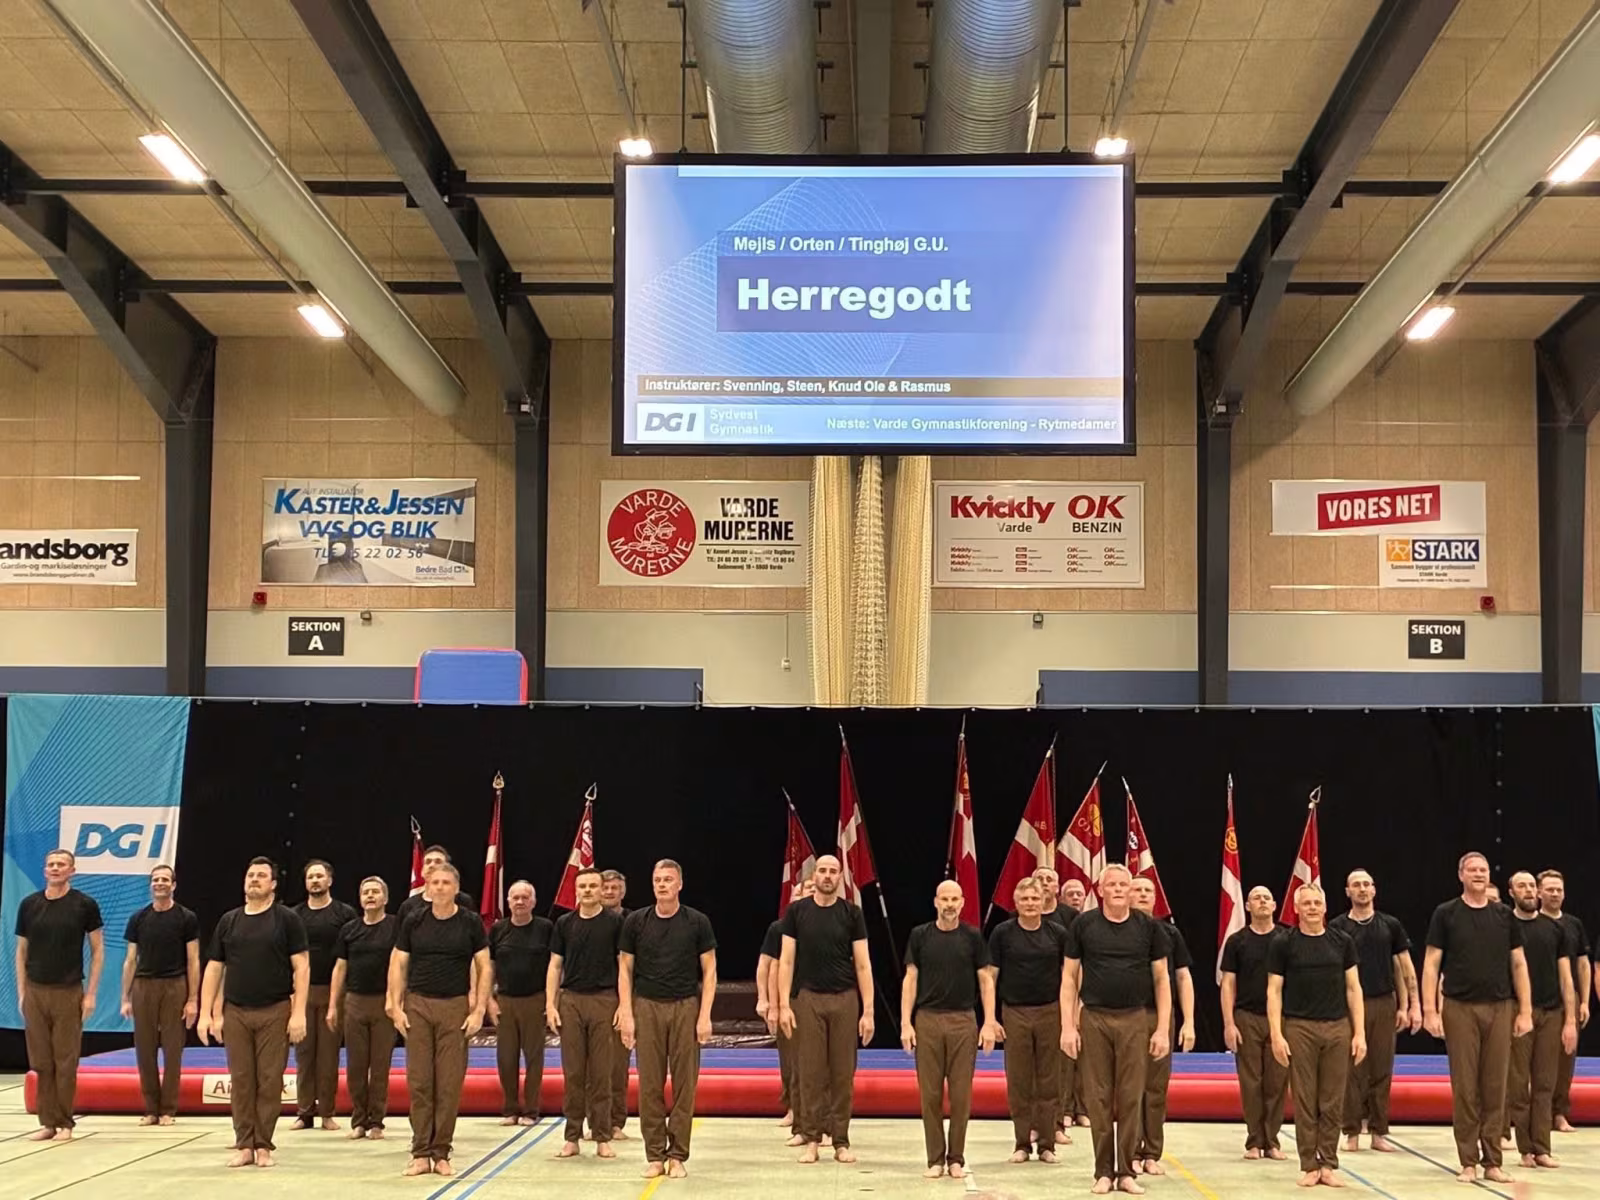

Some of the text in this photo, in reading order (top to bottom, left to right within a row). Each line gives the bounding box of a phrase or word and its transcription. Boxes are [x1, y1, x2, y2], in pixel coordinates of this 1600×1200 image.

[734, 237, 776, 254] Mejls
[790, 237, 834, 251] Orten
[848, 237, 909, 255] Tinghøj
[914, 237, 948, 251] G.U.
[738, 278, 971, 319] Herregodt
[645, 379, 951, 393] Instruktører: Svenning, Steen, Knud Ole & Rasmus
[644, 412, 697, 432] DGI
[710, 409, 758, 422] Sydvest
[710, 424, 774, 436] Gymnastik
[827, 418, 870, 430] Næste:
[873, 418, 908, 430] Varde
[911, 418, 1028, 432] Gymnastikforening
[1039, 418, 1117, 432] Rytmedamer
[274, 488, 465, 515] KASTER&JESSEN
[620, 491, 687, 518] VARDE
[720, 498, 779, 518] VARDE
[950, 494, 1128, 524] Kvickly OK
[1325, 493, 1433, 522] VORES NET
[299, 520, 439, 538] VVS OG BLIK
[704, 520, 794, 541] MURERNE
[997, 522, 1122, 533] Varde BENZIN
[0, 538, 129, 567] andsborg
[364, 547, 381, 559] 22
[386, 547, 402, 559] 02
[610, 536, 693, 575] MURERNE
[1413, 541, 1477, 560] STARK
[416, 565, 437, 573] Bedre
[438, 565, 453, 573] Bad
[291, 621, 341, 633] SEKTION
[1411, 624, 1461, 636] SEKTION
[308, 635, 324, 650] A
[1430, 638, 1443, 654] B
[74, 823, 167, 858] DGI
